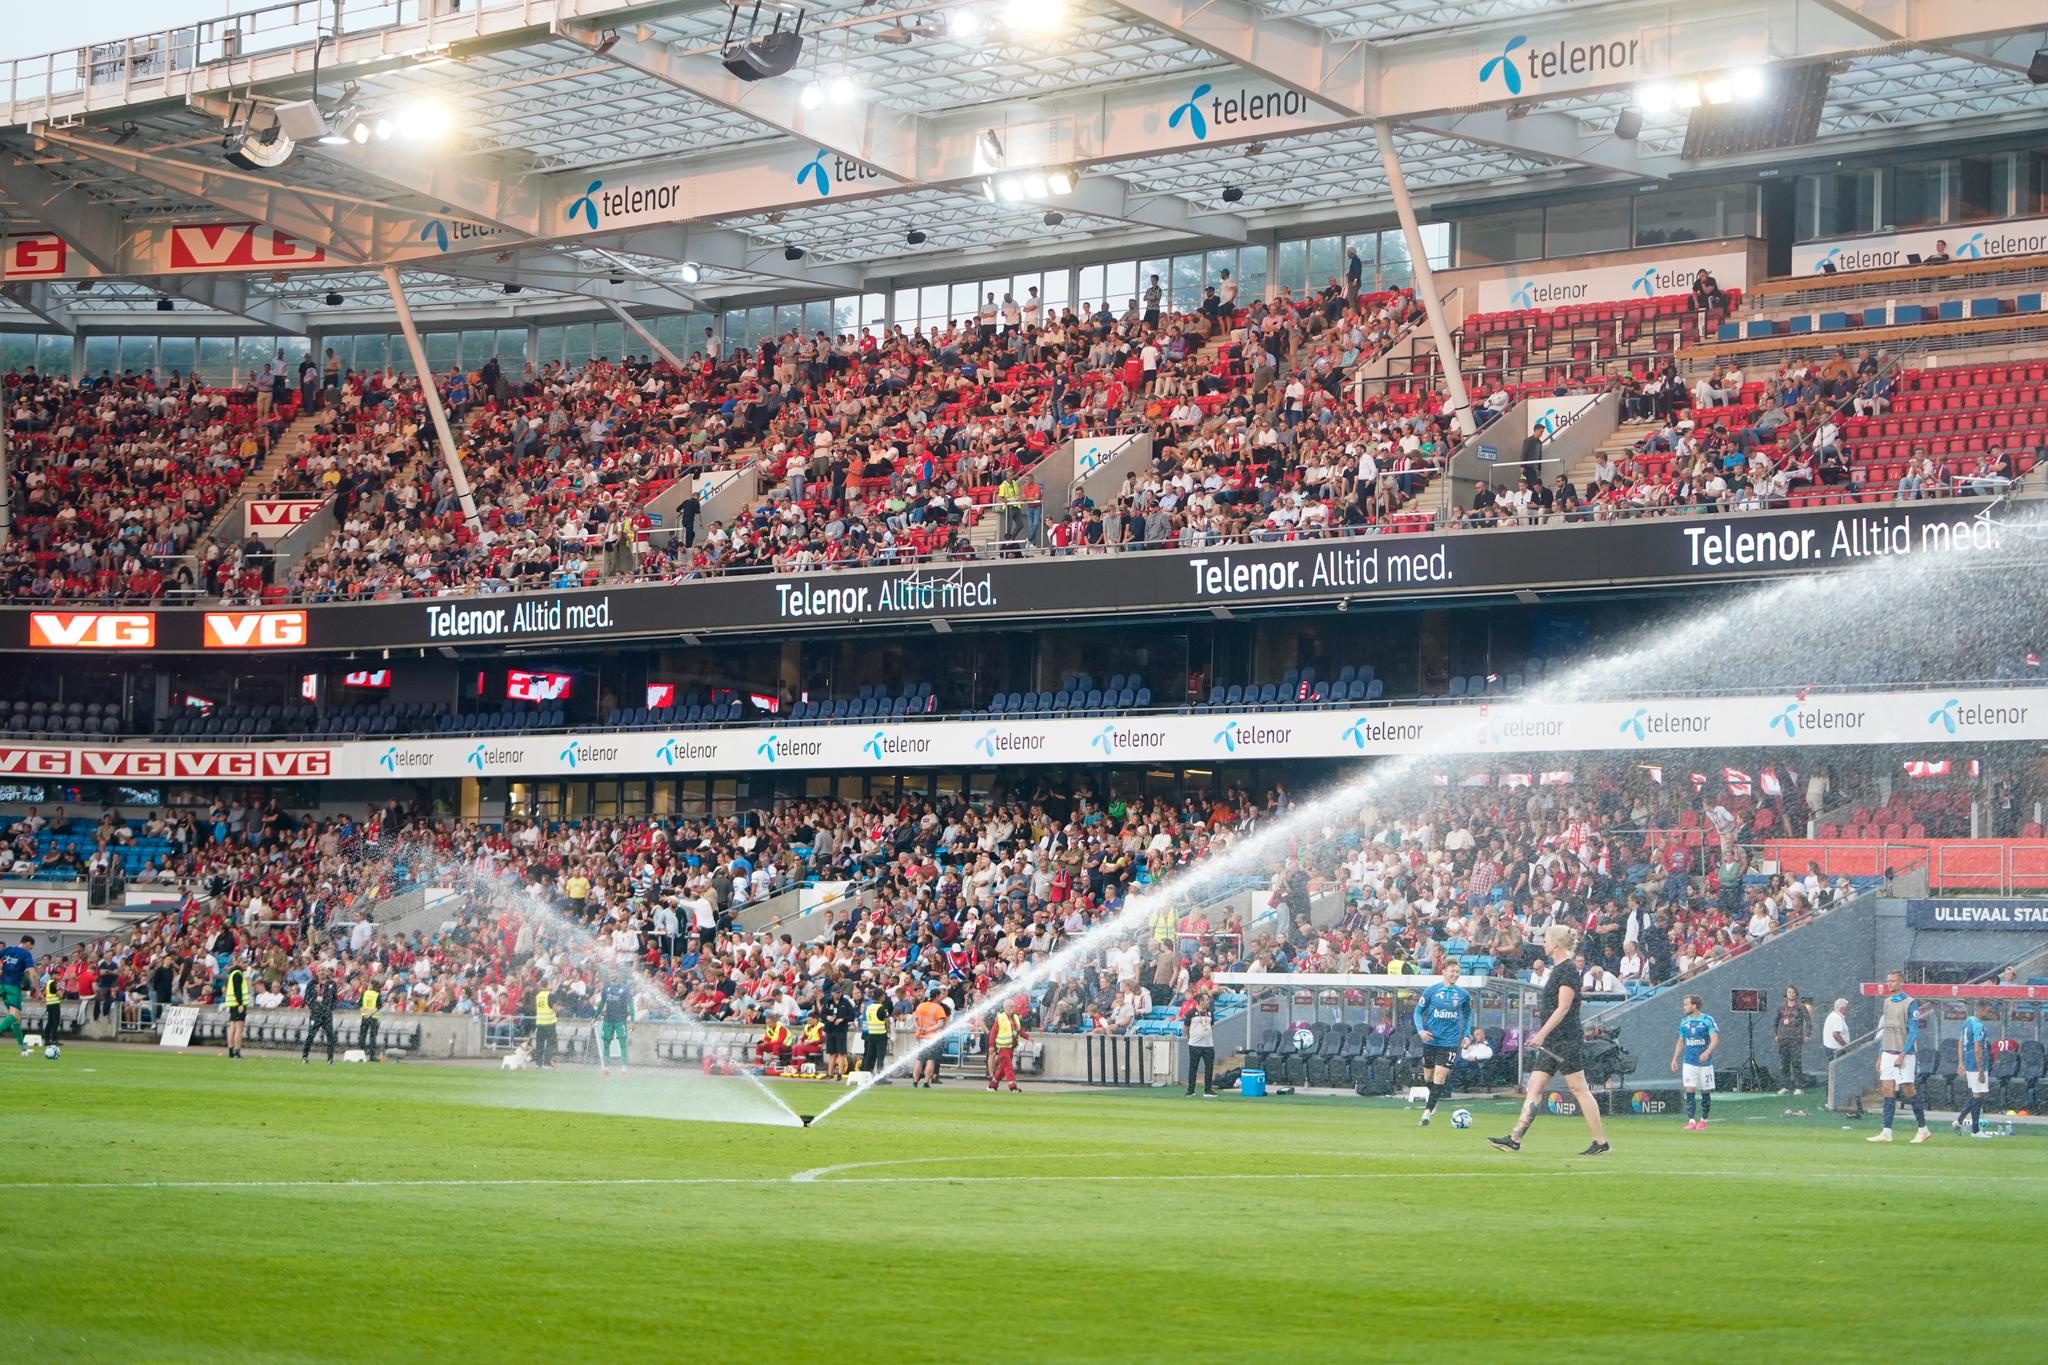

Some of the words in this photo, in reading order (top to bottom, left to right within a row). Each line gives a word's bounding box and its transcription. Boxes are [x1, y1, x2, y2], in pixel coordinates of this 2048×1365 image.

[1528, 40, 1639, 79] telenor
[603, 185, 680, 217] telenor
[174, 222, 318, 264] VG
[1984, 234, 2047, 255] telenor
[1840, 250, 1900, 270] telenor
[1533, 283, 1588, 303] telenor
[1683, 525, 1821, 566] Telenor.
[1831, 515, 1911, 558] Alltid
[1922, 510, 2000, 552] med.
[1190, 557, 1304, 594] Telenor.
[1312, 548, 1378, 587] Alltid
[1388, 544, 1453, 583] med.
[776, 582, 872, 617] Telenor.
[878, 576, 935, 611] Alltid
[943, 573, 997, 609] med.
[426, 605, 509, 637] Telenor.
[513, 599, 561, 632] Alltid
[566, 597, 614, 629] med.
[33, 615, 149, 645] VG
[207, 614, 302, 645] VG
[1647, 713, 1711, 733] telenor
[1797, 708, 1865, 729] telenor
[1957, 703, 2028, 725] telenor
[1236, 725, 1291, 744] telenor
[1365, 722, 1424, 741] telenor
[1504, 717, 1564, 737] telenor
[776, 738, 822, 757] telenor
[883, 735, 930, 753] telenor
[995, 732, 1046, 751] telenor
[1112, 729, 1165, 748] telenor
[395, 750, 434, 766] telenor
[484, 748, 524, 764] telenor
[577, 745, 618, 761] telenor
[674, 742, 718, 759] telenor
[0, 750, 66, 773] VG
[83, 752, 161, 775] VG
[177, 752, 252, 775] VG
[265, 753, 327, 775] VG
[0, 898, 73, 922] VG
[1935, 907, 2010, 921] ULLEVAAL
[1448, 1052, 1457, 1063] 12
[1705, 1074, 1713, 1083] 21
[1556, 1102, 1576, 1114] NEP
[1642, 1101, 1666, 1113] NEP
